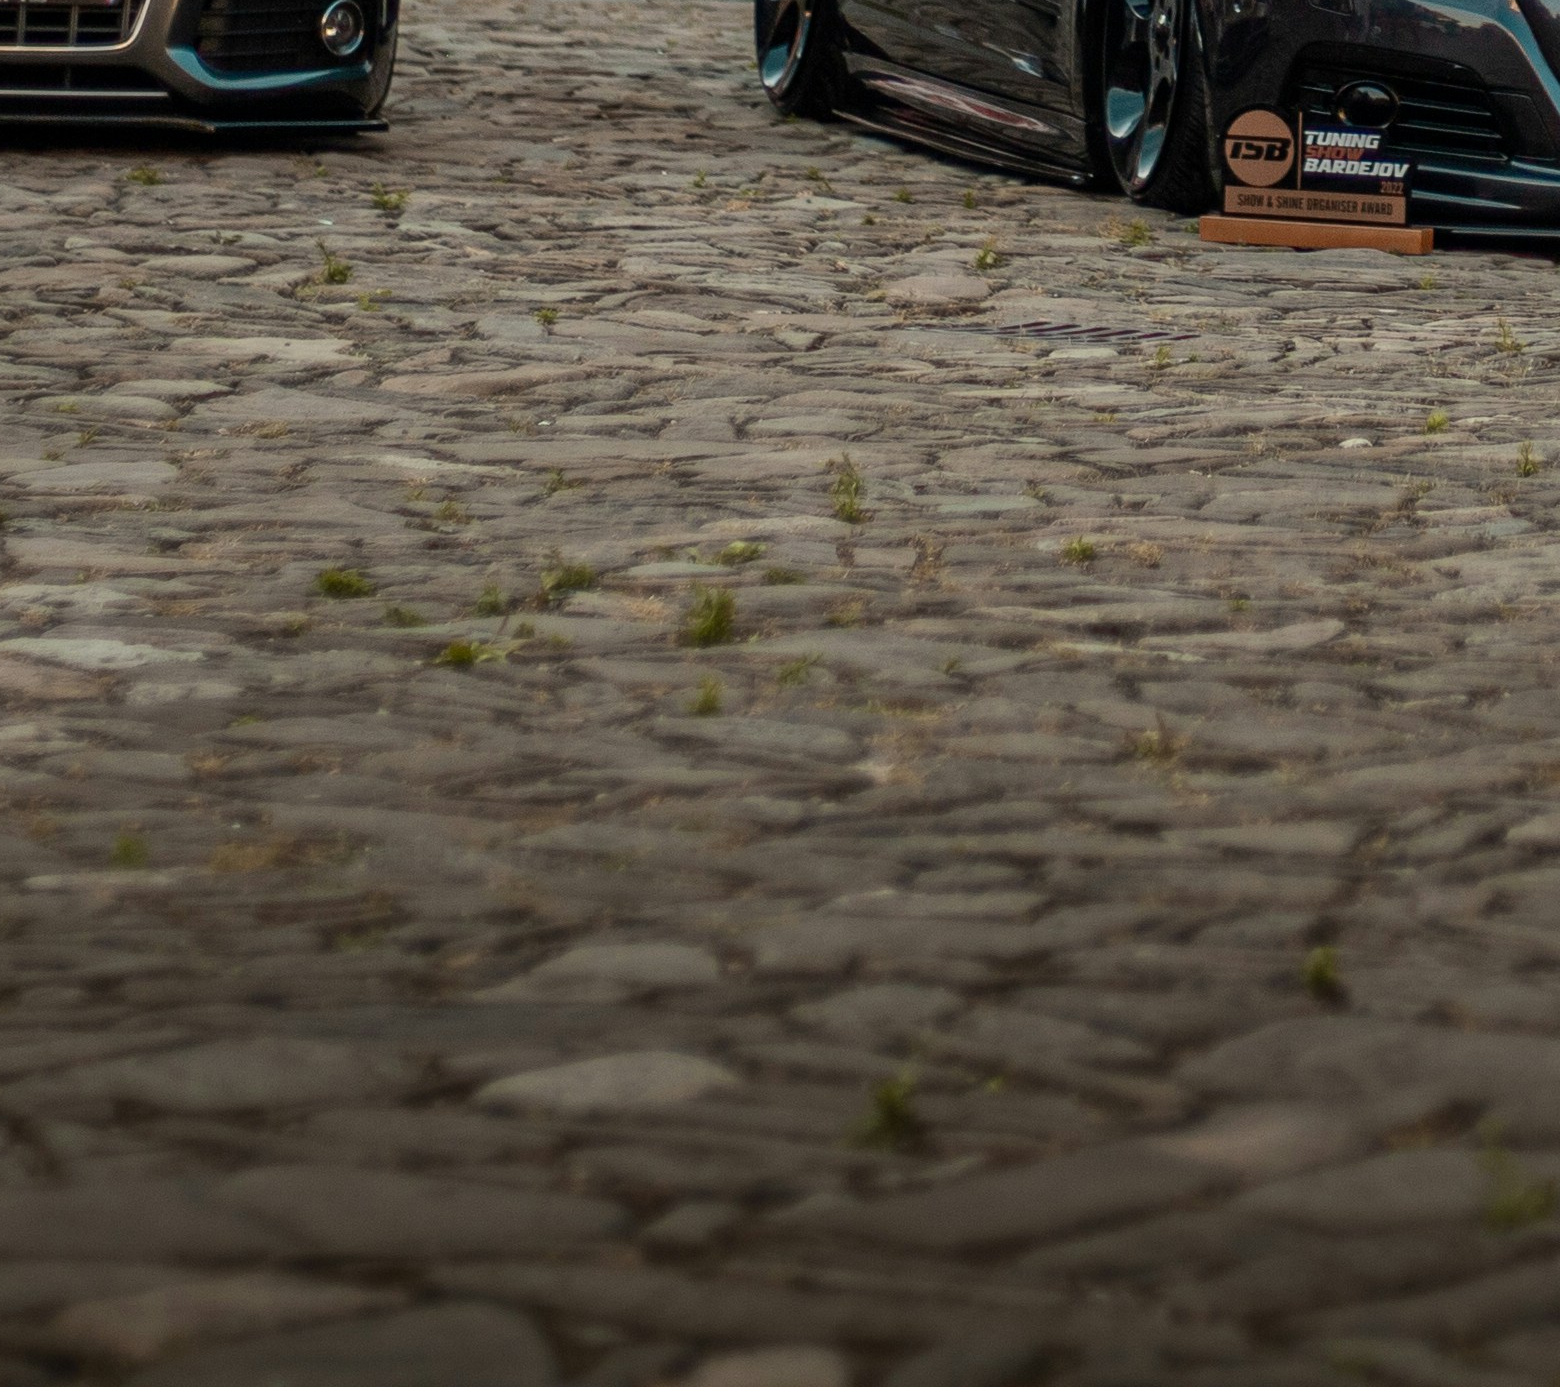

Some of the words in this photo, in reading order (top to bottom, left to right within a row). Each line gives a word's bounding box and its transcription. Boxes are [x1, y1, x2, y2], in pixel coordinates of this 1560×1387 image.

[1303, 130, 1382, 149] TUNING
[1304, 146, 1365, 160] SHOW
[1303, 158, 1410, 178] BARDEJOV
[1237, 193, 1264, 207] SHOW
[1266, 195, 1274, 208] &
[1276, 196, 1304, 211] SHINE
[1306, 197, 1359, 213] ORGANISER
[1360, 201, 1394, 216] AWARD
